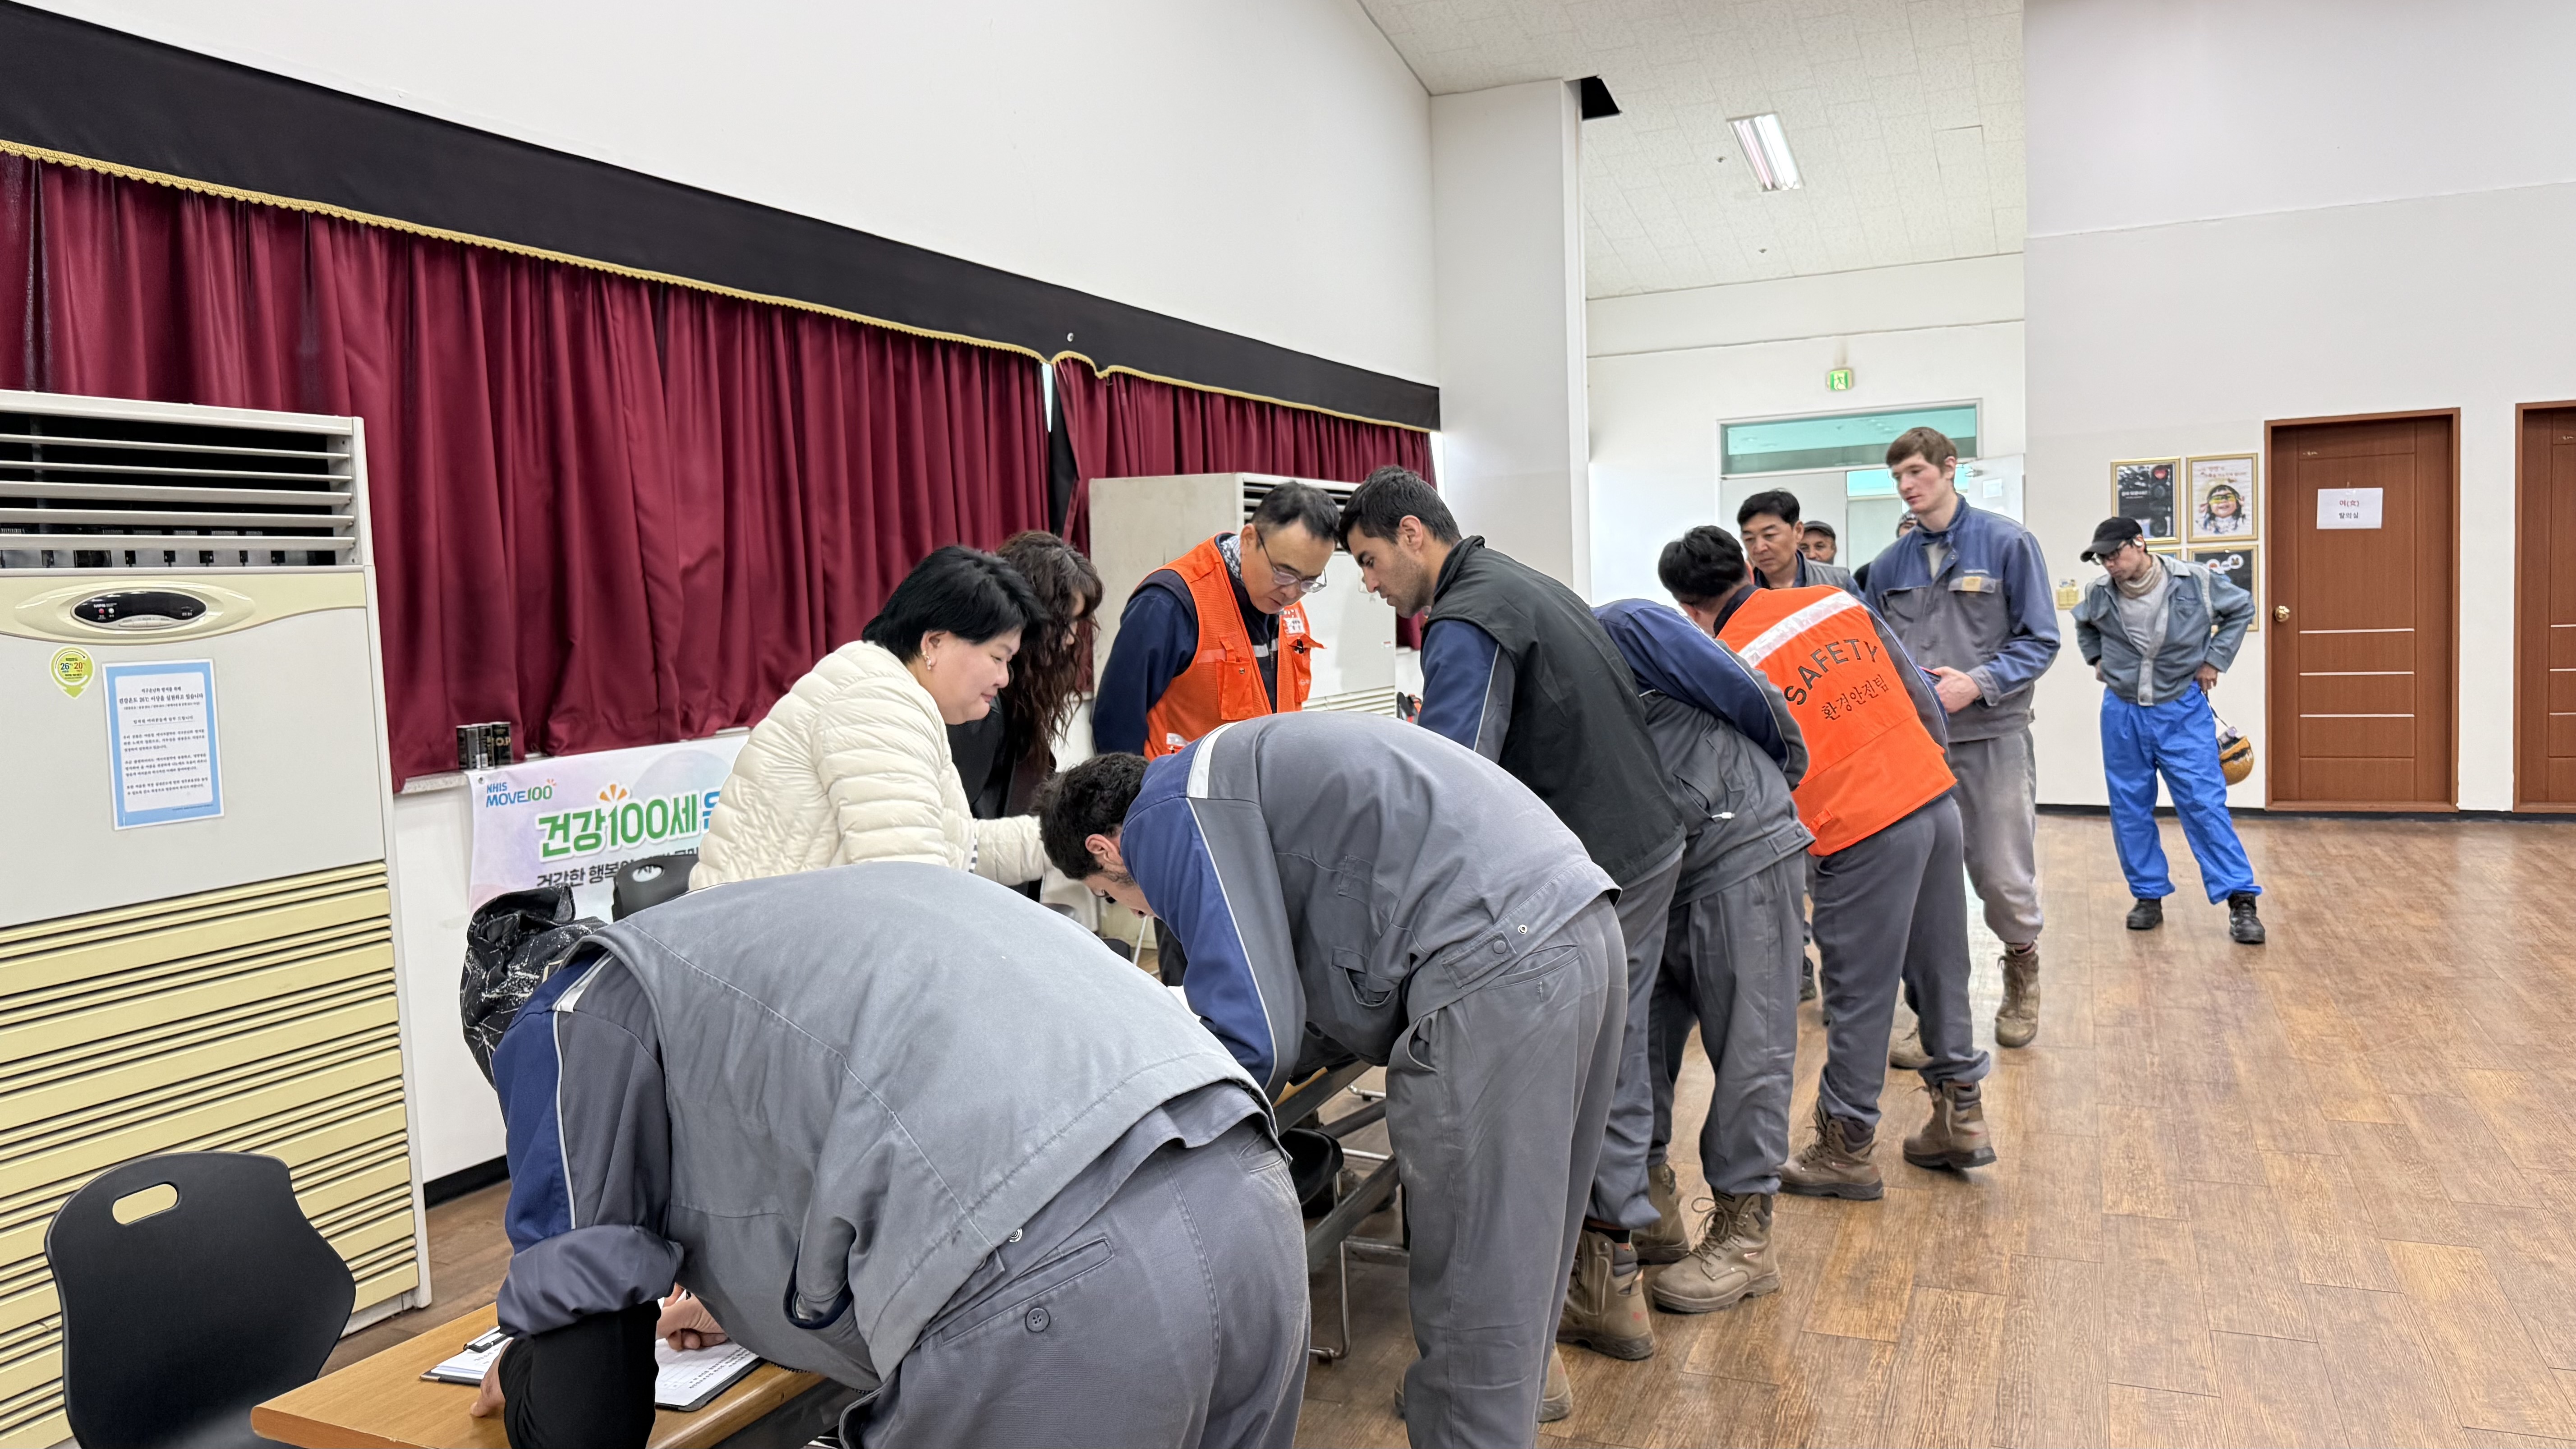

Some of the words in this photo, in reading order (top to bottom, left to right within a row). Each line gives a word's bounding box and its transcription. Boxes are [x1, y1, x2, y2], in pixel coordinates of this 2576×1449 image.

[1784, 639, 1877, 705] SAFETY
[1821, 674, 1889, 720] 환경안전팀
[486, 785, 552, 808] MOVE100
[487, 782, 507, 794] NHIS
